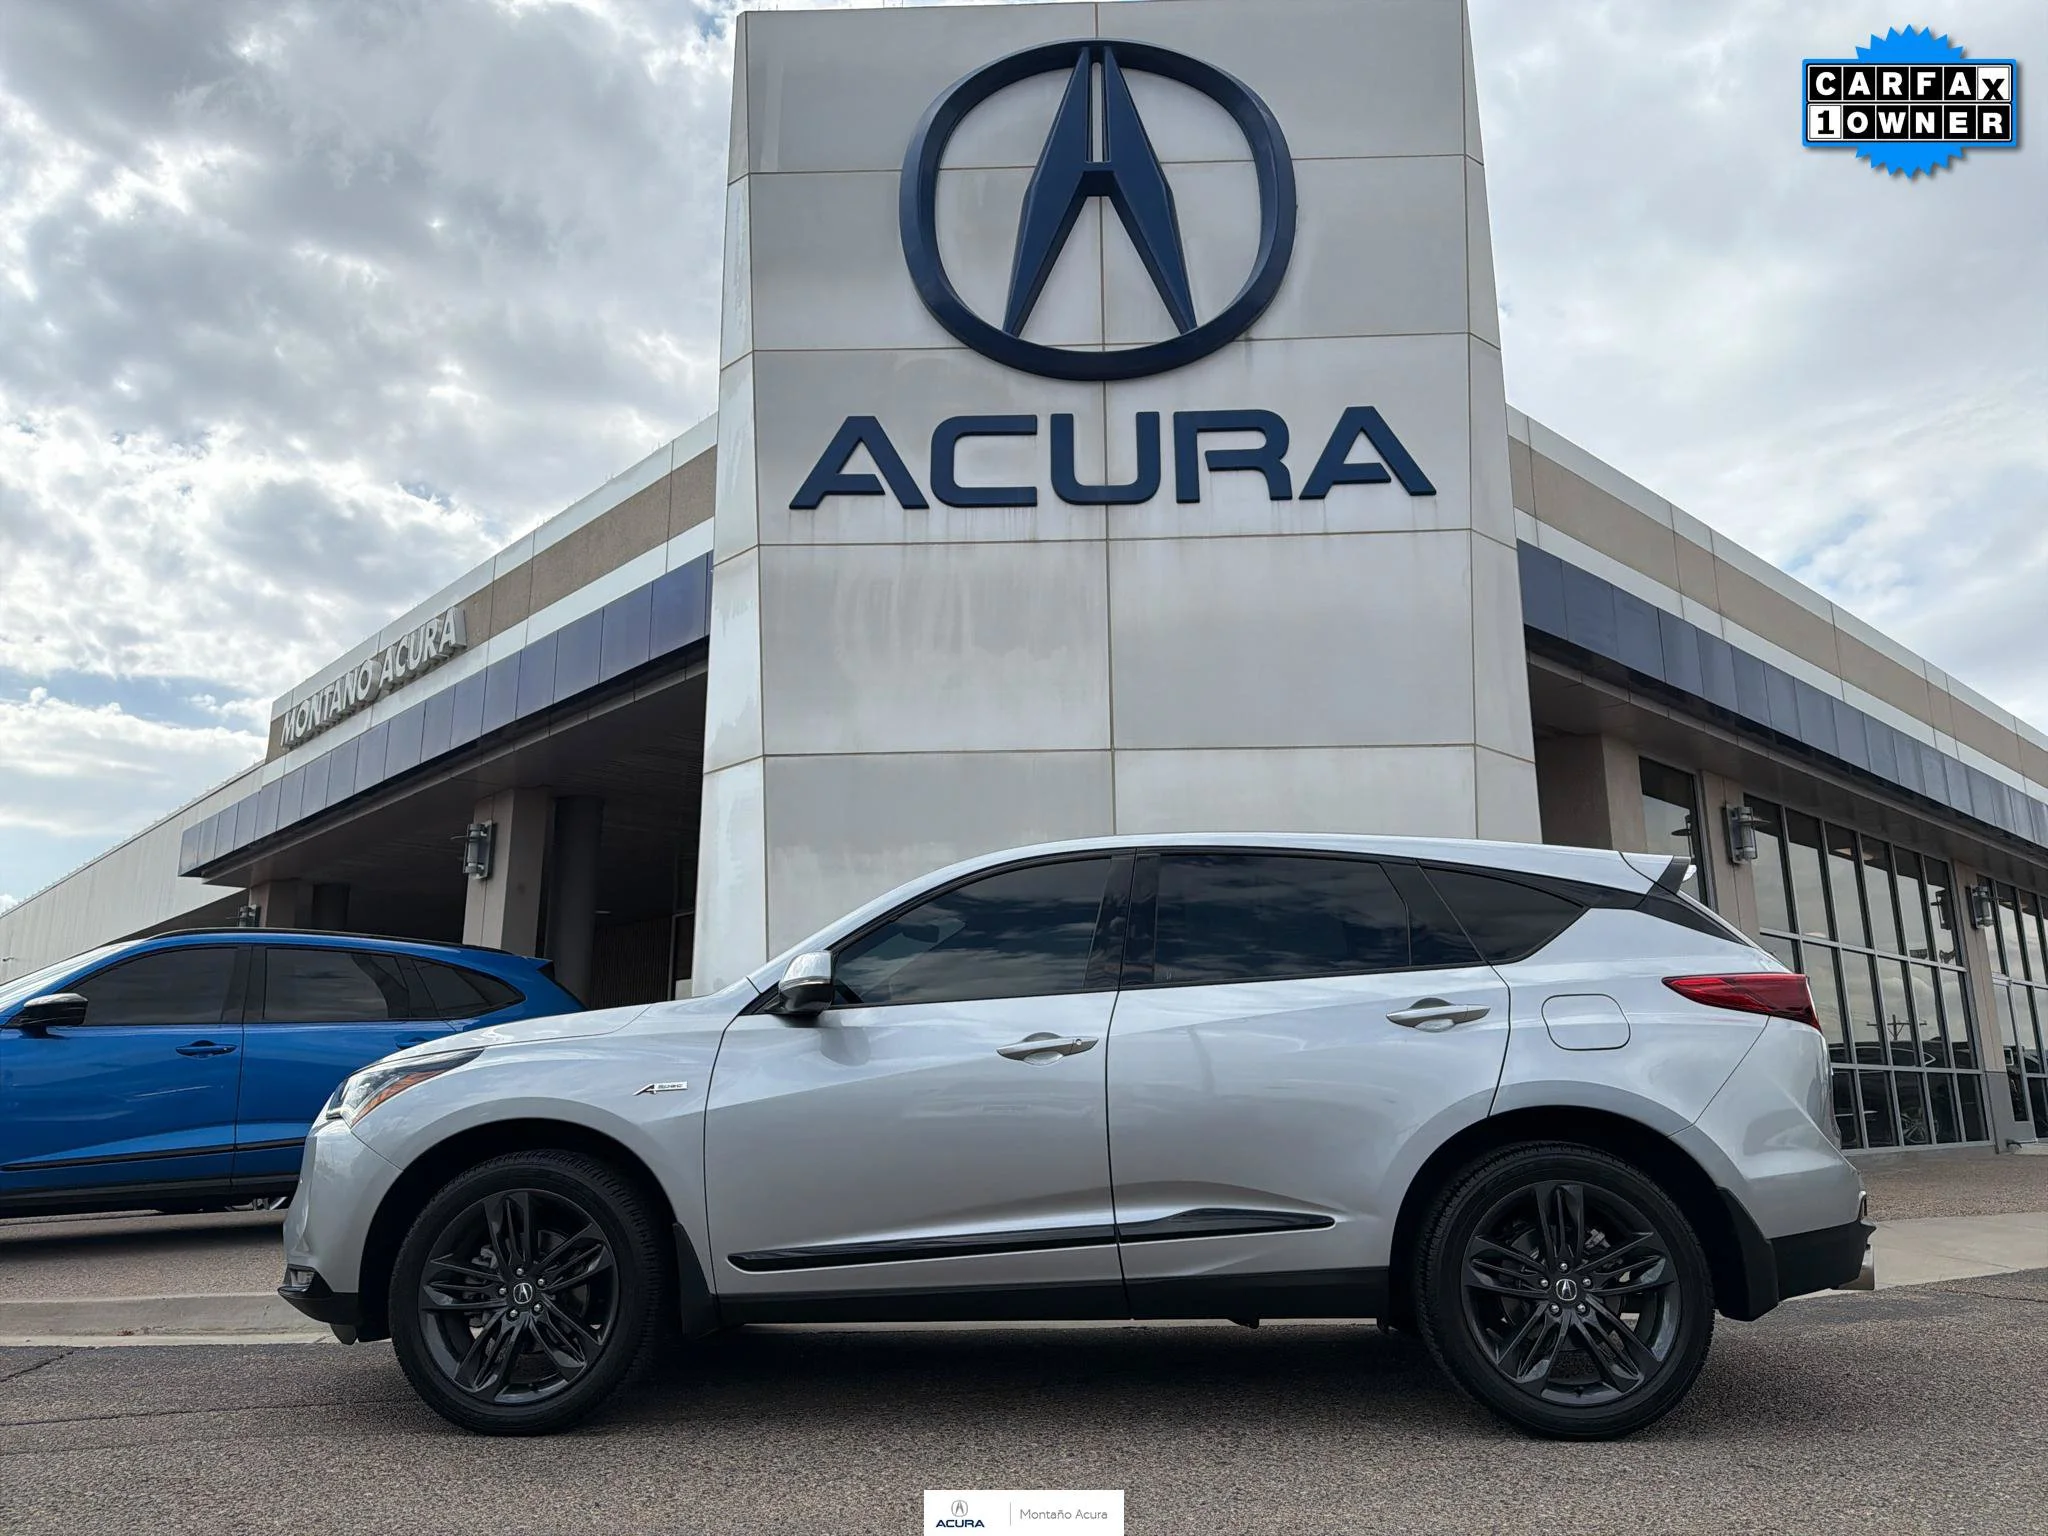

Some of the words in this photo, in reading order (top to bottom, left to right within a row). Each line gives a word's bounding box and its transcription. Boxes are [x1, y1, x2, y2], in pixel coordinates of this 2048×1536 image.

[789, 406, 1437, 510] ACURA
[280, 659, 383, 750] MONTANO
[379, 606, 468, 690] ACURA
